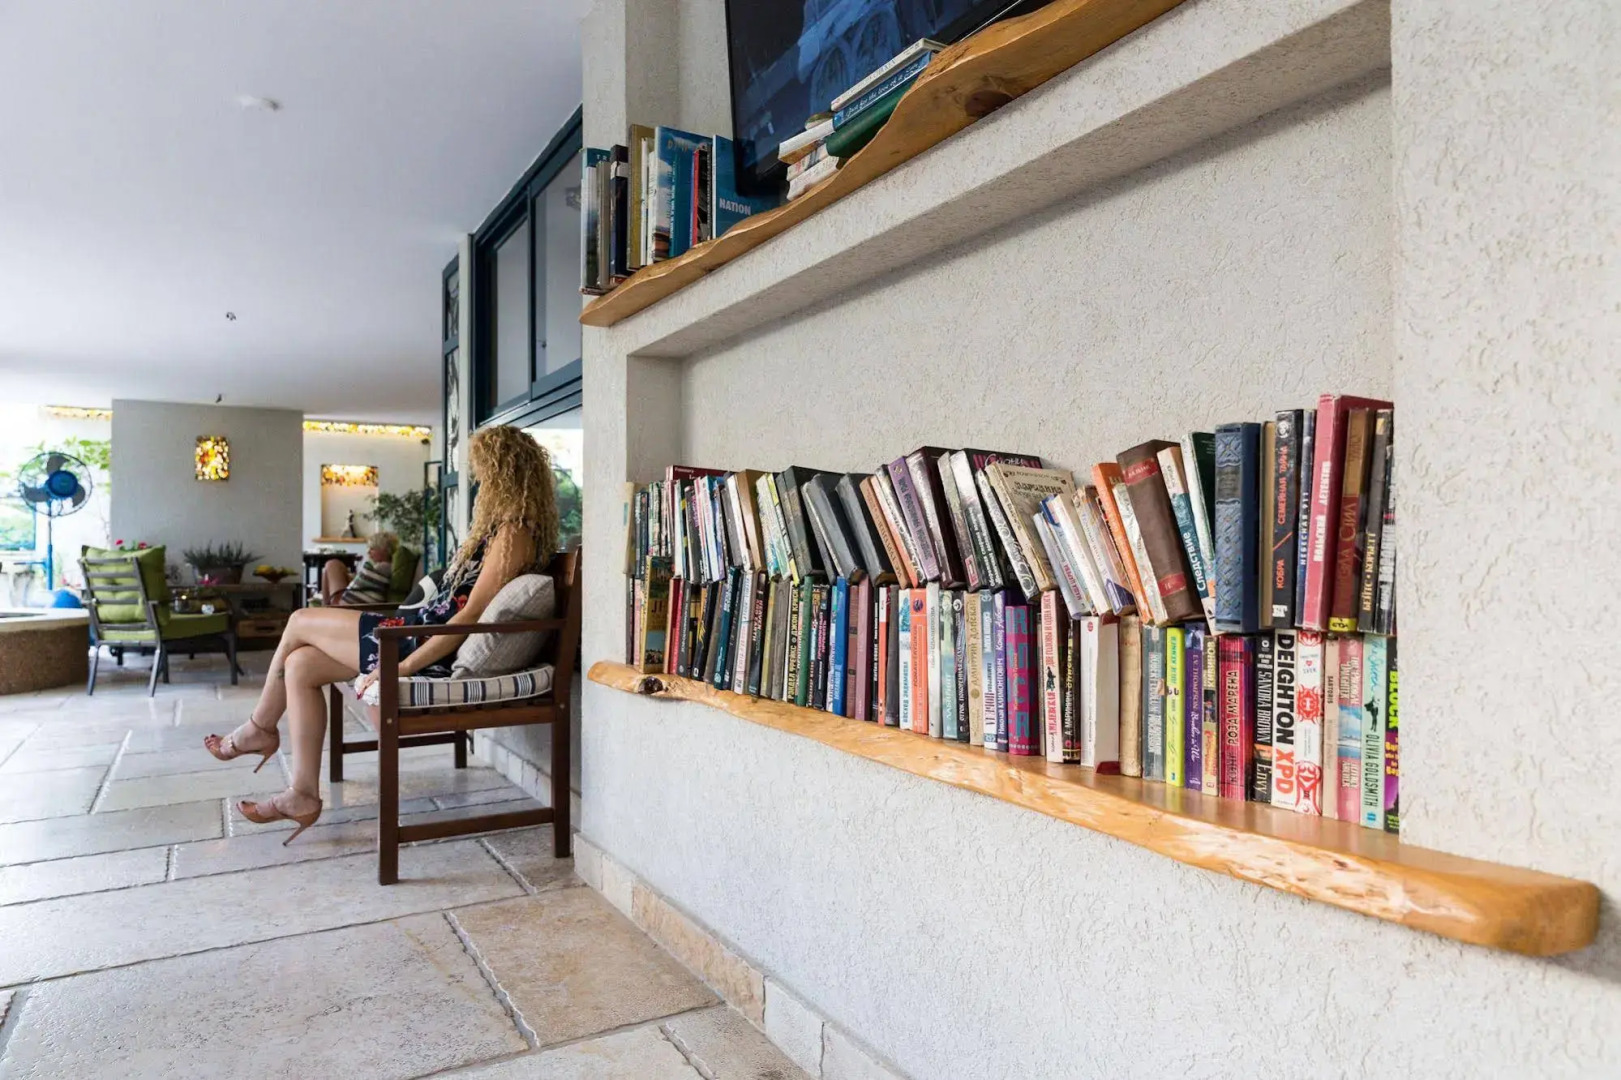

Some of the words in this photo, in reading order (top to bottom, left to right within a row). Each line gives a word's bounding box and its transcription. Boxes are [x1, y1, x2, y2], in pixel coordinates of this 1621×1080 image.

[718, 198, 752, 216] NATION
[1279, 446, 1288, 473] ТАЙНА
[1277, 477, 1287, 524] СЕМЕЙНАЯ
[1318, 460, 1331, 506] ДЕТЕКТИВ
[1300, 513, 1308, 565] НЕБЕСНАЯ
[1313, 514, 1327, 562] ПОЛЬСКИЙ
[1183, 532, 1206, 591] Следствие
[1276, 559, 1285, 588] КОБРА
[1065, 691, 1073, 728] МАРИНИНА
[1227, 671, 1239, 715] МАРЕНА
[1256, 671, 1271, 707] SANDRA
[1276, 633, 1295, 745] DEIGHTON
[1388, 670, 1399, 729] BLOCK
[1227, 719, 1239, 746] РОЗА
[1256, 709, 1271, 743] BROWN
[1365, 734, 1379, 760] OLIVIA
[1255, 763, 1271, 794] Envy
[1275, 748, 1294, 794] XPD
[1364, 762, 1379, 807] GOLDSMITH
